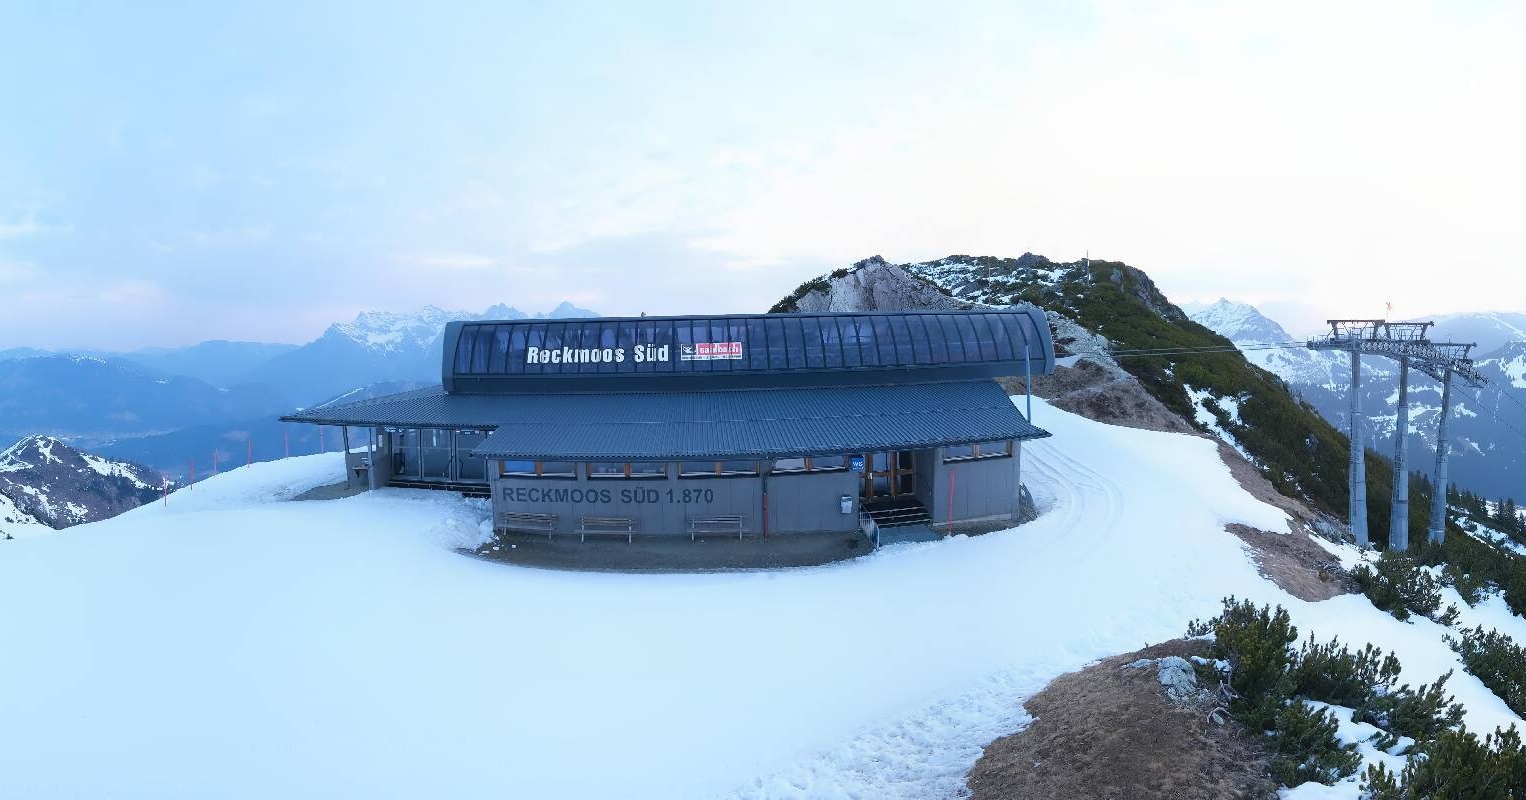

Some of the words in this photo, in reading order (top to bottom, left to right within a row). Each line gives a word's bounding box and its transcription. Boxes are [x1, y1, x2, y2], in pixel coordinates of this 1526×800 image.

[526, 346, 625, 364] Reckmoos
[633, 343, 669, 362] Süd
[502, 487, 611, 504] RECKMOOS
[621, 486, 660, 504] SÜD
[666, 488, 714, 504] 1.870
